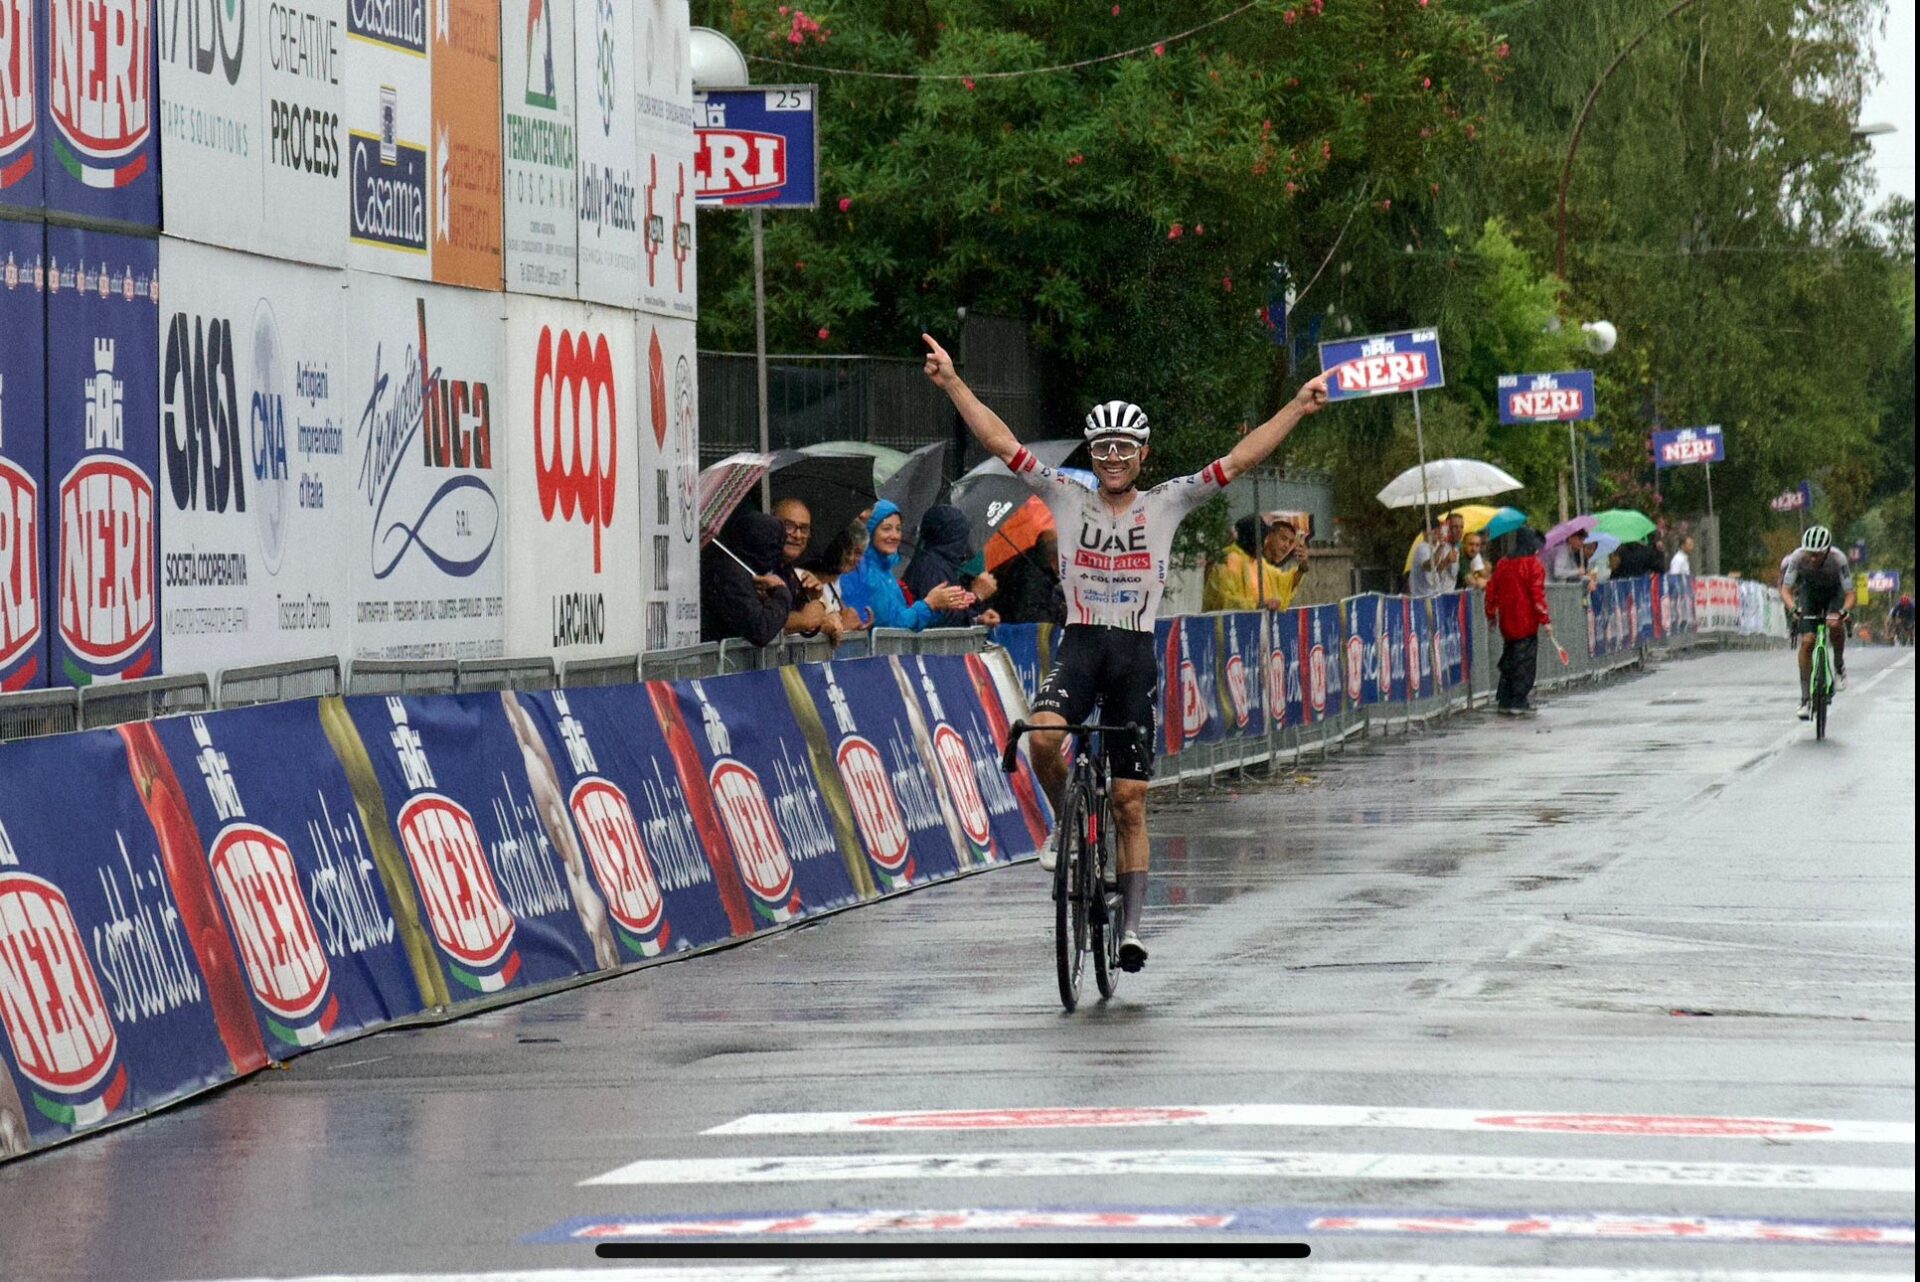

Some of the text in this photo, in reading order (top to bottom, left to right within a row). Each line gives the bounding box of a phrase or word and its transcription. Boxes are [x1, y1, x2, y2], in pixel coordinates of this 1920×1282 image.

[268, 2, 338, 85] CREATIVE
[351, 0, 423, 46] Casamia
[52, 0, 149, 139] NERI
[776, 90, 801, 109] 25
[190, 107, 249, 157] SOLUTIONS
[271, 98, 339, 179] PROCESS
[507, 113, 575, 170] TERMOTECNICA
[353, 140, 423, 243] Casamia
[508, 168, 575, 211] TOSCANA
[580, 160, 603, 238] Jolly
[604, 166, 636, 233] Plastic
[296, 360, 328, 409] Artigiani
[1340, 354, 1425, 388] NERI
[1512, 390, 1580, 416] NERI
[251, 390, 288, 481] CNA
[297, 418, 343, 463] Imprenditori
[534, 325, 617, 574] coop
[1663, 439, 1715, 461] NERI
[299, 472, 324, 509] d'Italia
[62, 473, 152, 645] NERI
[165, 544, 248, 587] SOCIETÀ COOPERATIVA
[1079, 552, 1150, 570] Emirates
[1080, 522, 1147, 553] UAE
[1090, 575, 1142, 584] COLNAGO
[306, 593, 331, 630] Centro
[552, 591, 605, 648] LARCIANO
[715, 768, 792, 889] NERI
[839, 746, 909, 858] NERI
[403, 808, 514, 952] NERI
[574, 789, 661, 919] NERI
[214, 839, 327, 1001] NERI
[0, 890, 114, 1074] NERI
